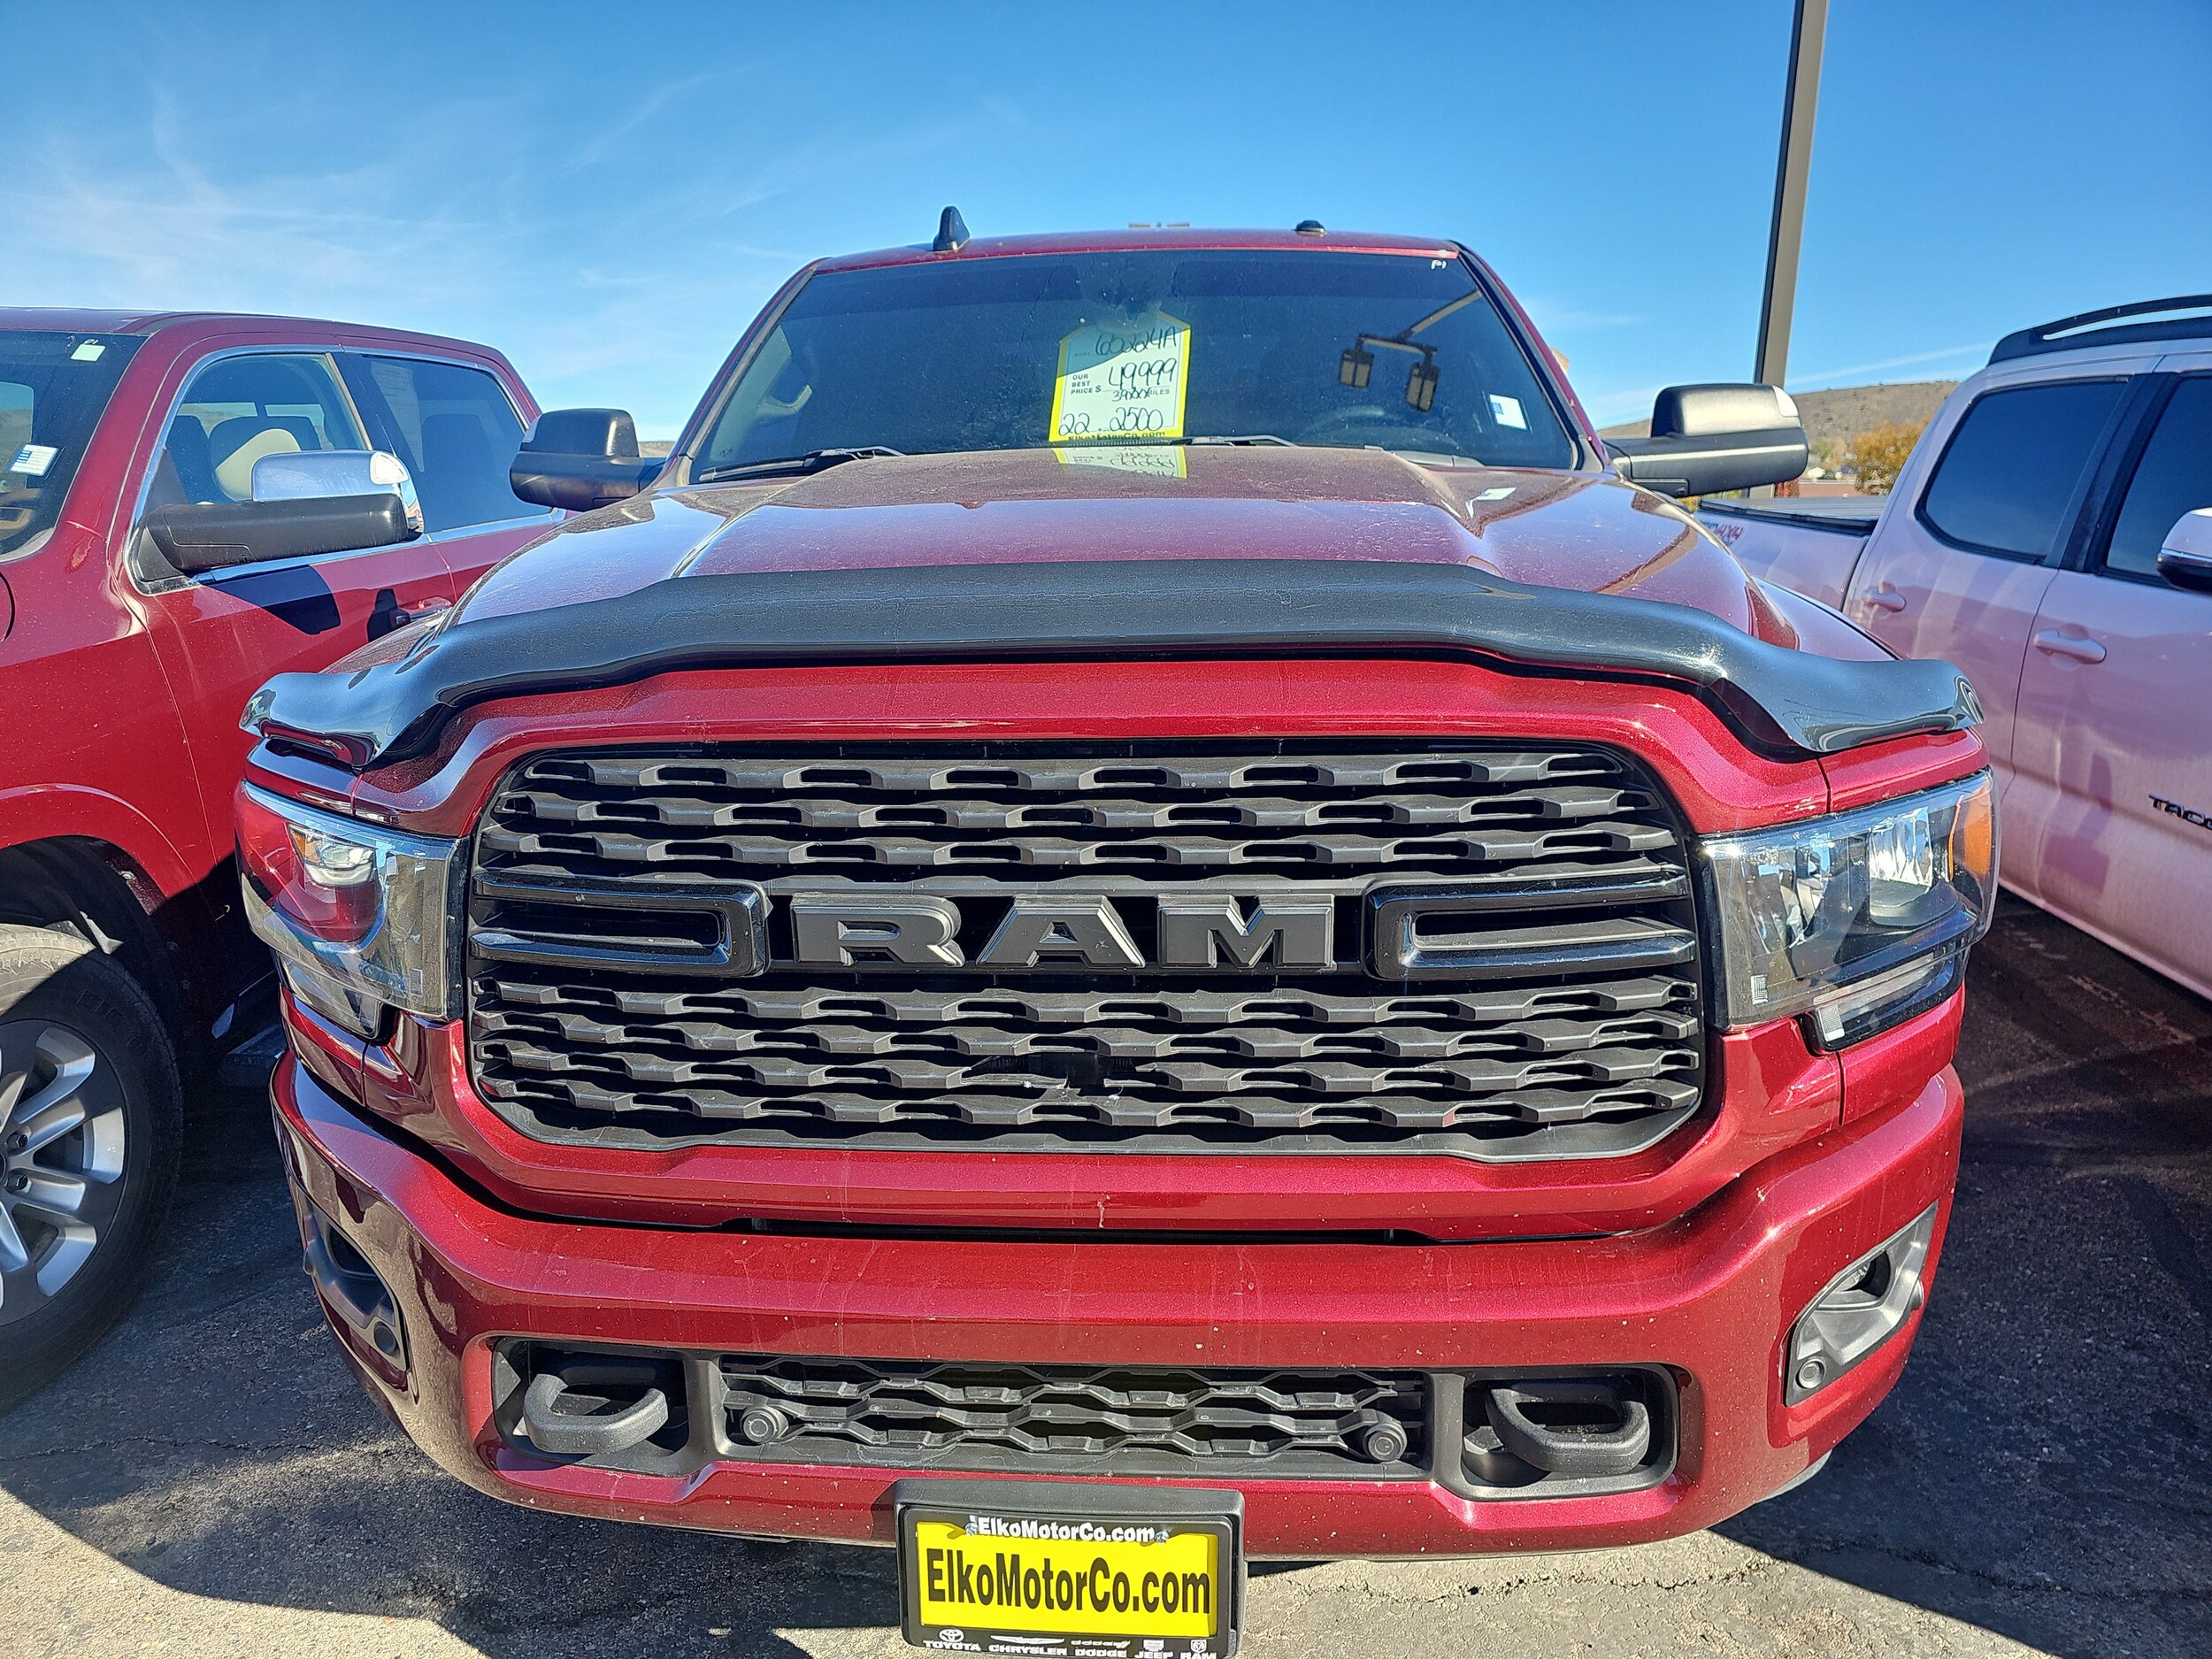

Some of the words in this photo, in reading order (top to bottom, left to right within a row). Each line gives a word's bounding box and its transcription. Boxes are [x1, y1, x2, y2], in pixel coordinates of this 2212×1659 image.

[1059, 412, 1090, 436] 22
[1110, 406, 1164, 431] 2500
[790, 893, 1337, 968] RAM
[978, 1516, 1156, 1543] ElkoMotorCo.com
[926, 1548, 1210, 1615] ElkoMotorCo.com
[923, 1640, 982, 1652] TOYOTA
[988, 1644, 1068, 1656] CHRYSLER
[1075, 1648, 1127, 1658] DODGE
[1134, 1650, 1174, 1659] JEEP
